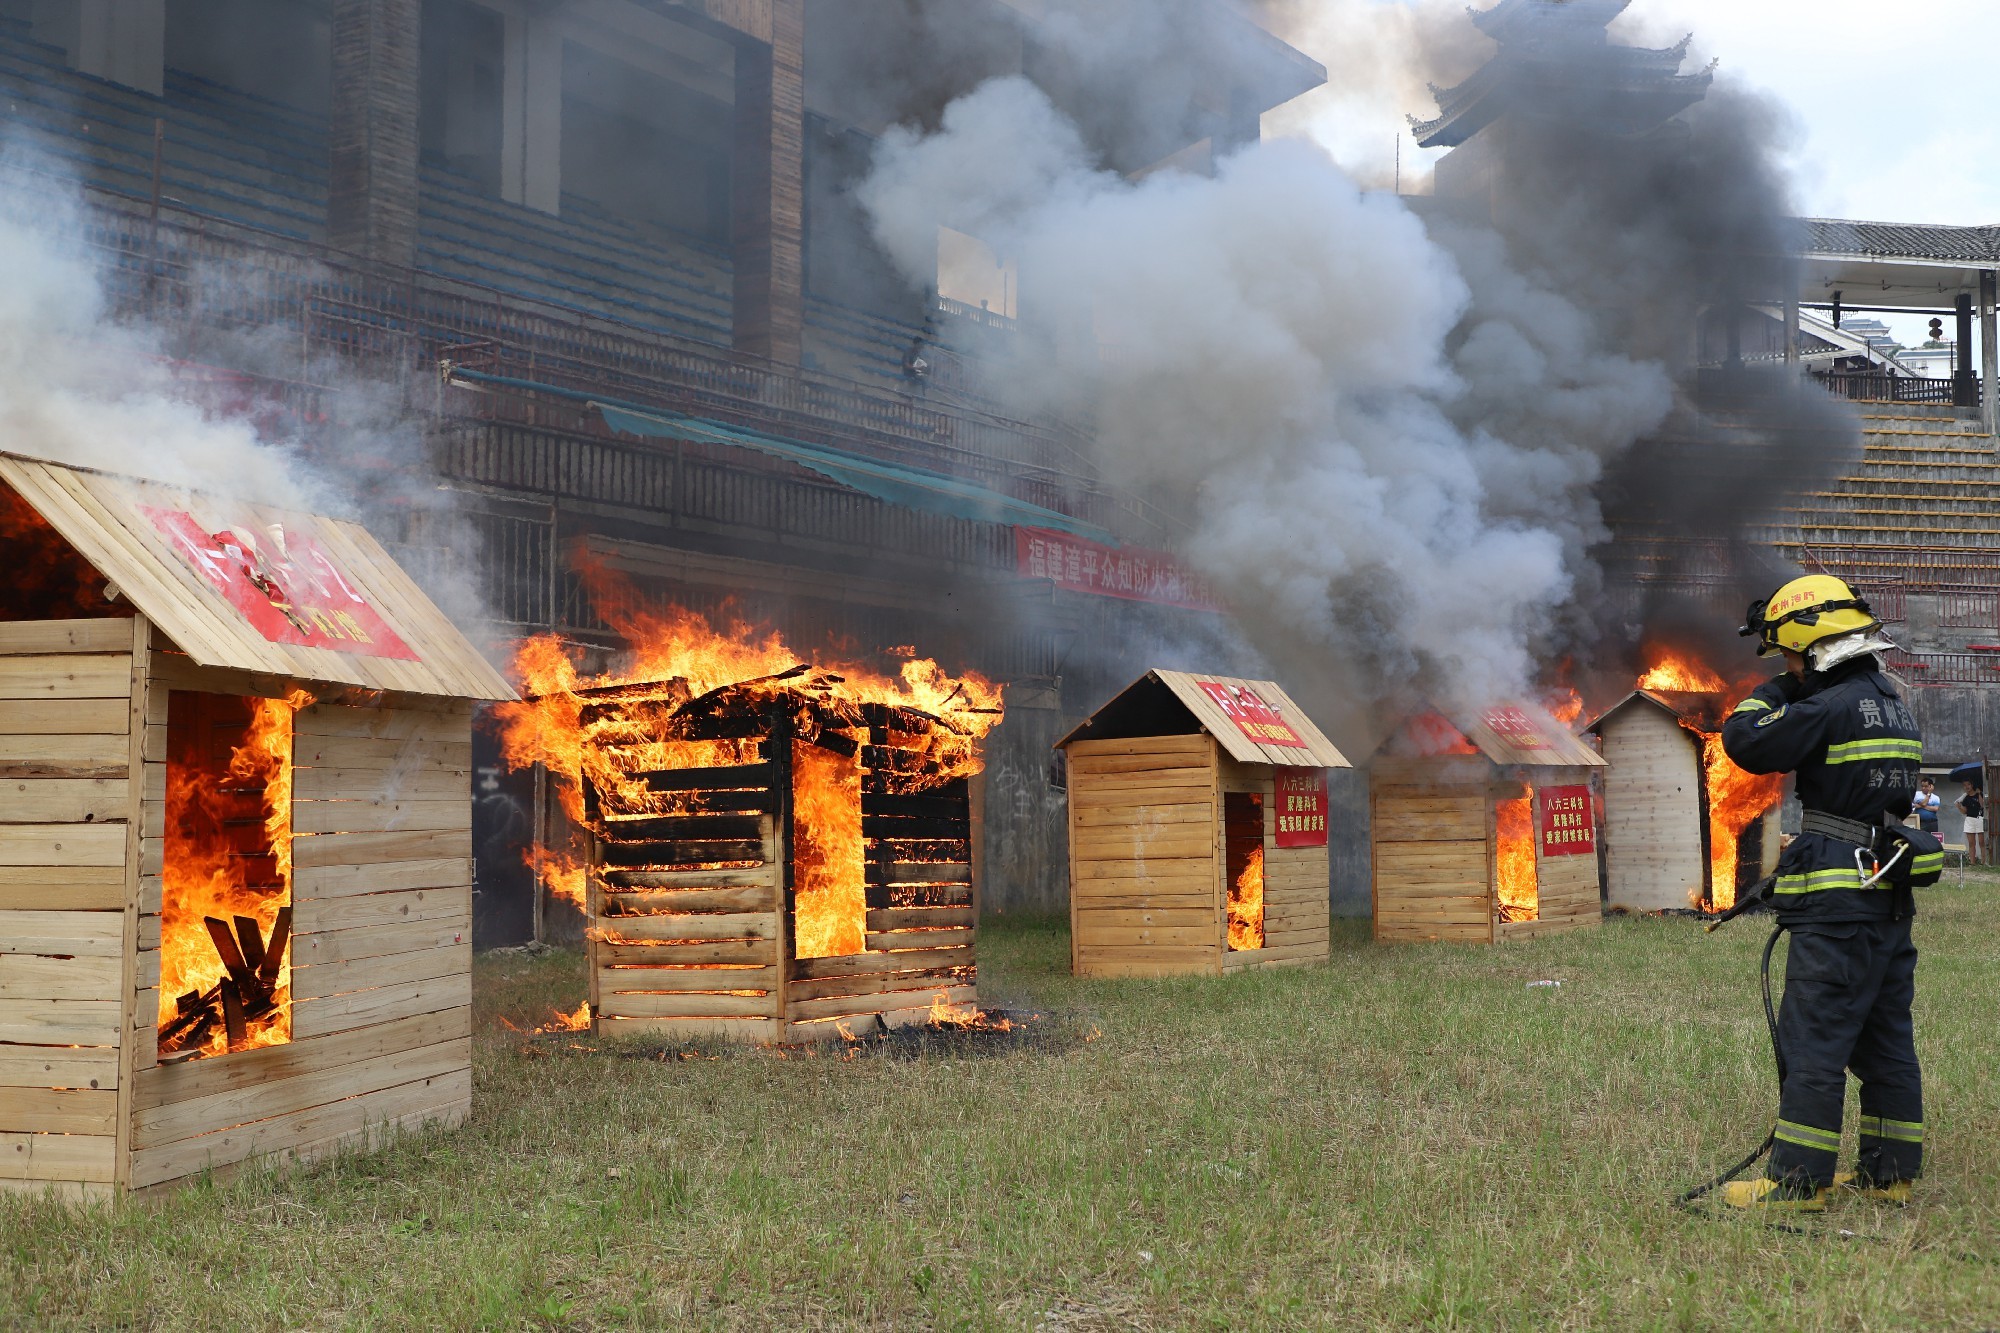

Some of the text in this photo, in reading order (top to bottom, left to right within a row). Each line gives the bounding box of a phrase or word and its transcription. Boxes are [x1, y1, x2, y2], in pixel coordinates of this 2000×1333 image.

[1770, 591, 1815, 617] 贵州消防
[1547, 796, 1584, 811] 八六三科技
